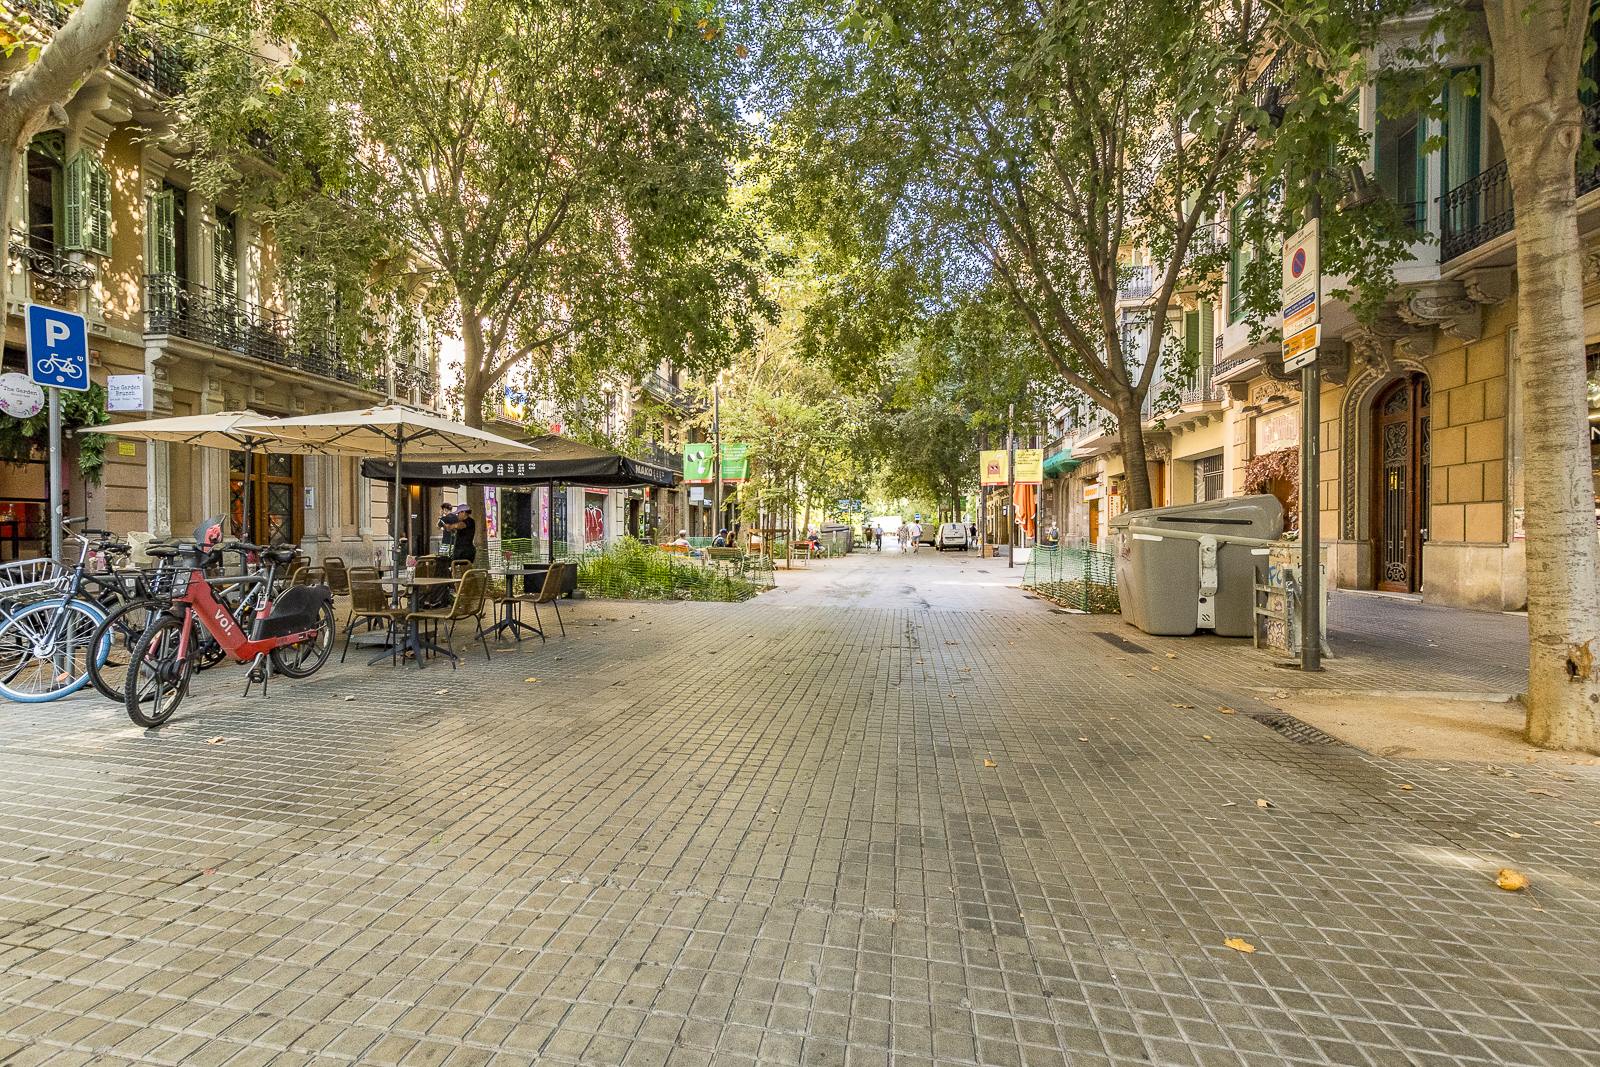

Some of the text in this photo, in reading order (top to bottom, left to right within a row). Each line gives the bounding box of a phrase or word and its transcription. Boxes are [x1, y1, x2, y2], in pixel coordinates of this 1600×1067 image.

[46, 319, 70, 347] P
[441, 463, 494, 475] MAKO
[635, 465, 652, 477] MAKO
